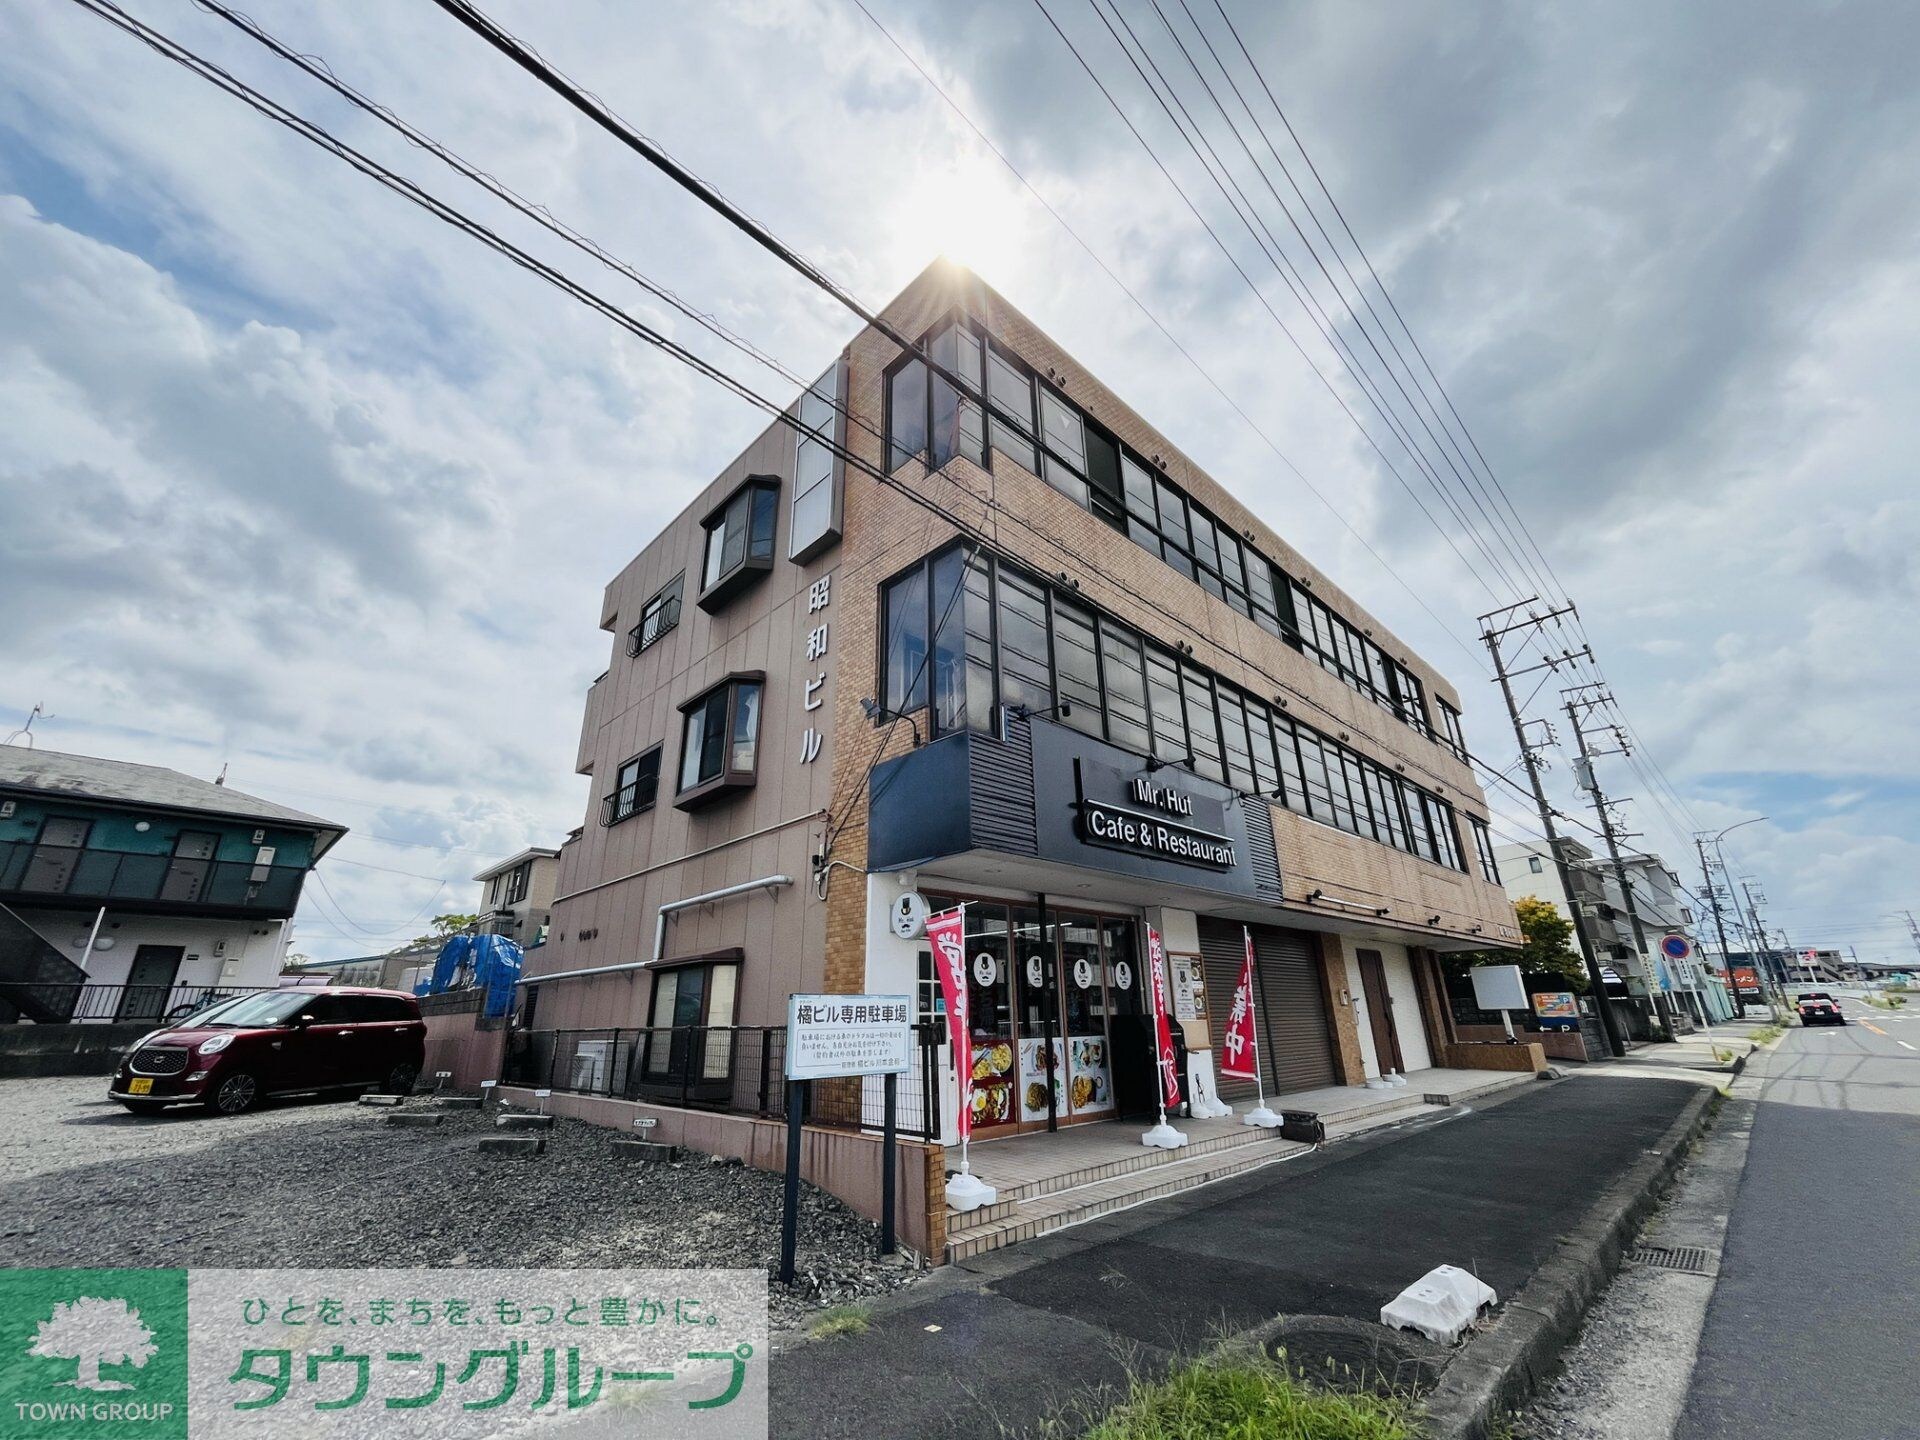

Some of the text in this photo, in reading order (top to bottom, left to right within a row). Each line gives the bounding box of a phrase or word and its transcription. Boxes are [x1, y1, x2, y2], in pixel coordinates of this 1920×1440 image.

[799, 574, 832, 764] 昭和ビル
[1135, 778, 1194, 816] Mr. Hut
[1091, 810, 1238, 866] Cafe & Restaurant
[797, 1004, 907, 1025] 橘ビル専用駐車場
